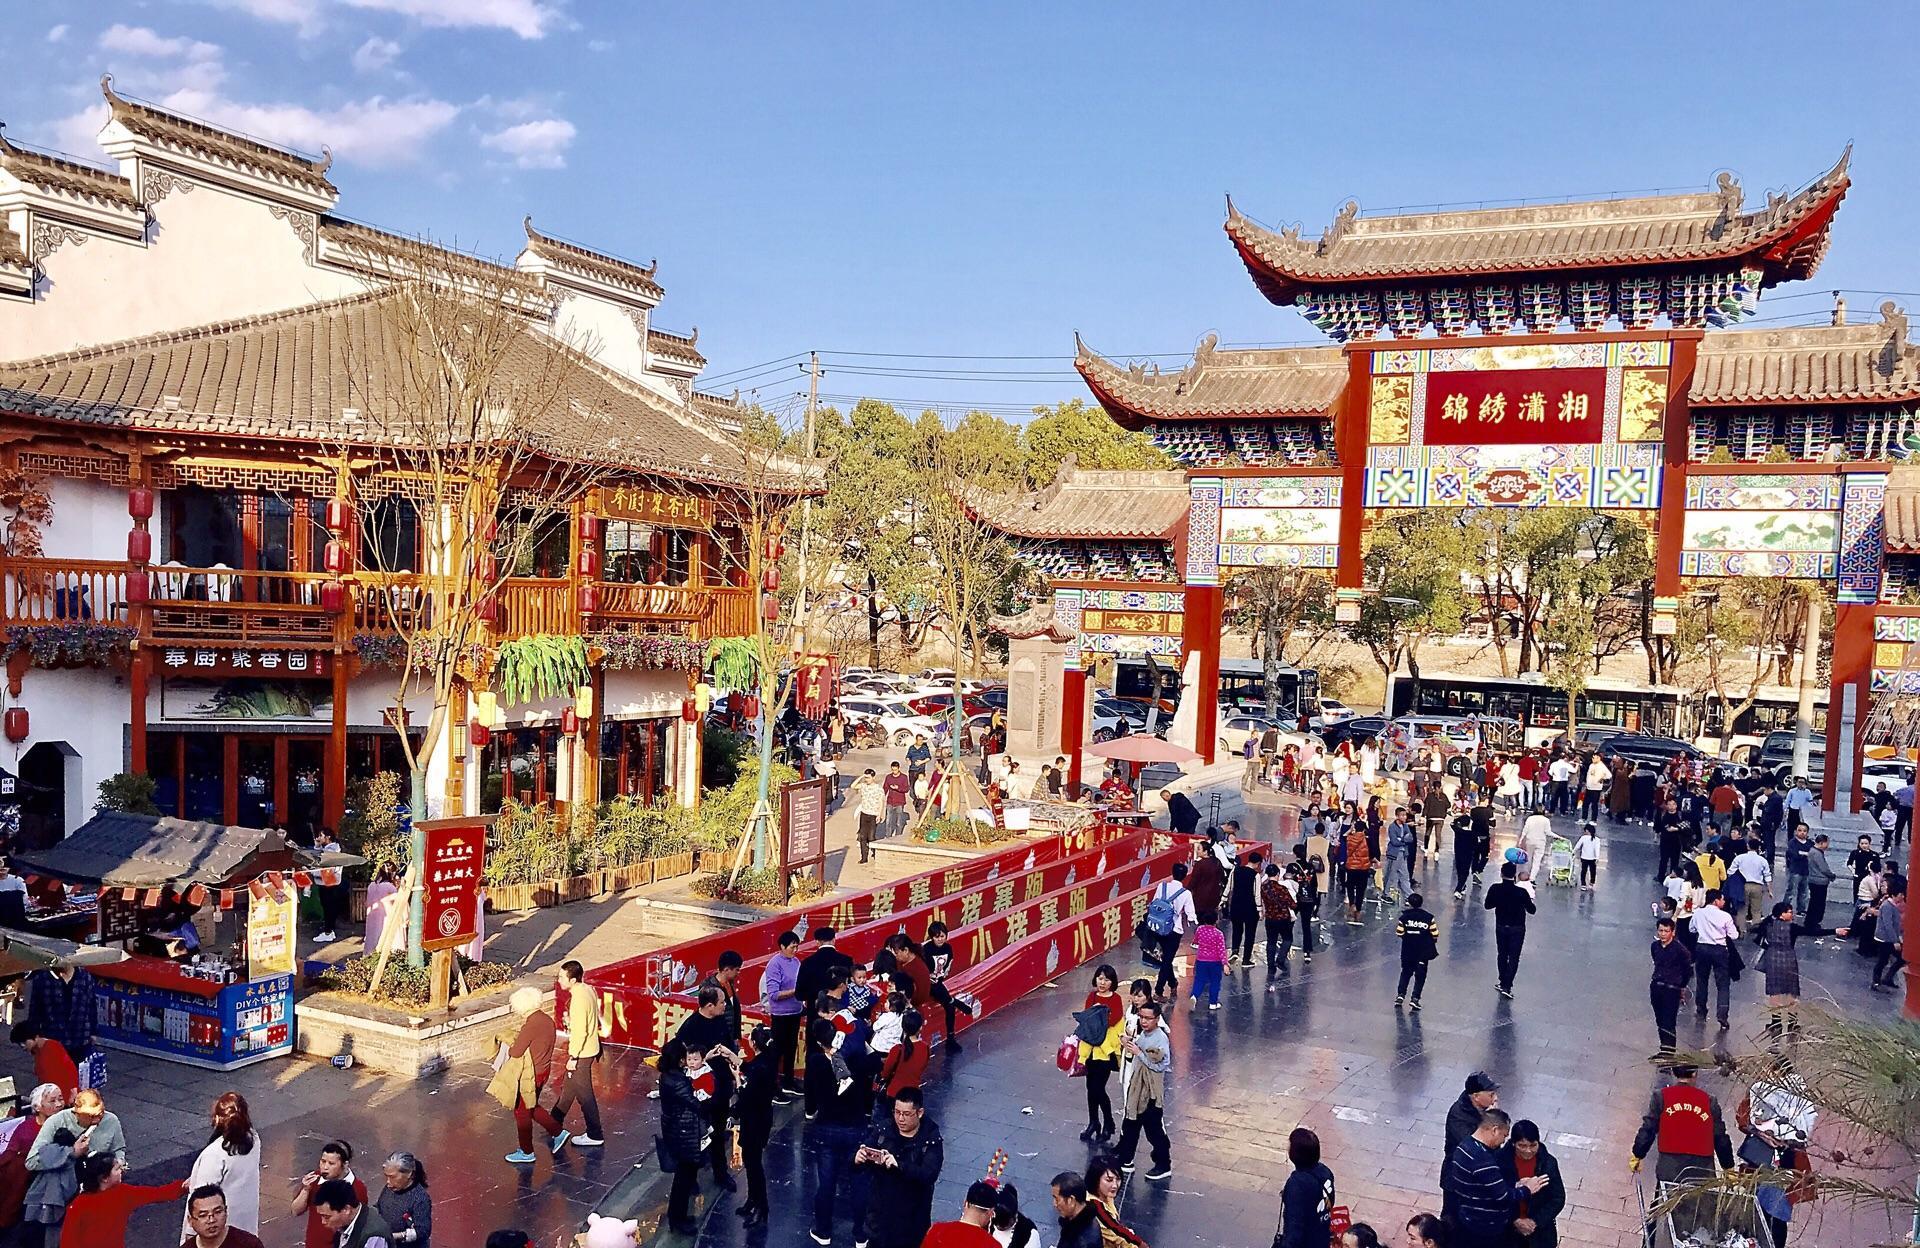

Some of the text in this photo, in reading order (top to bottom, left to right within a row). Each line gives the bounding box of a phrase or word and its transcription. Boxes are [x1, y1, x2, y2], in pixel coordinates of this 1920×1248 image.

[164, 648, 308, 671] 奉厨·聚香园
[829, 868, 964, 935] 小猪赛跑
[970, 886, 1087, 966] 小猪赛跑
